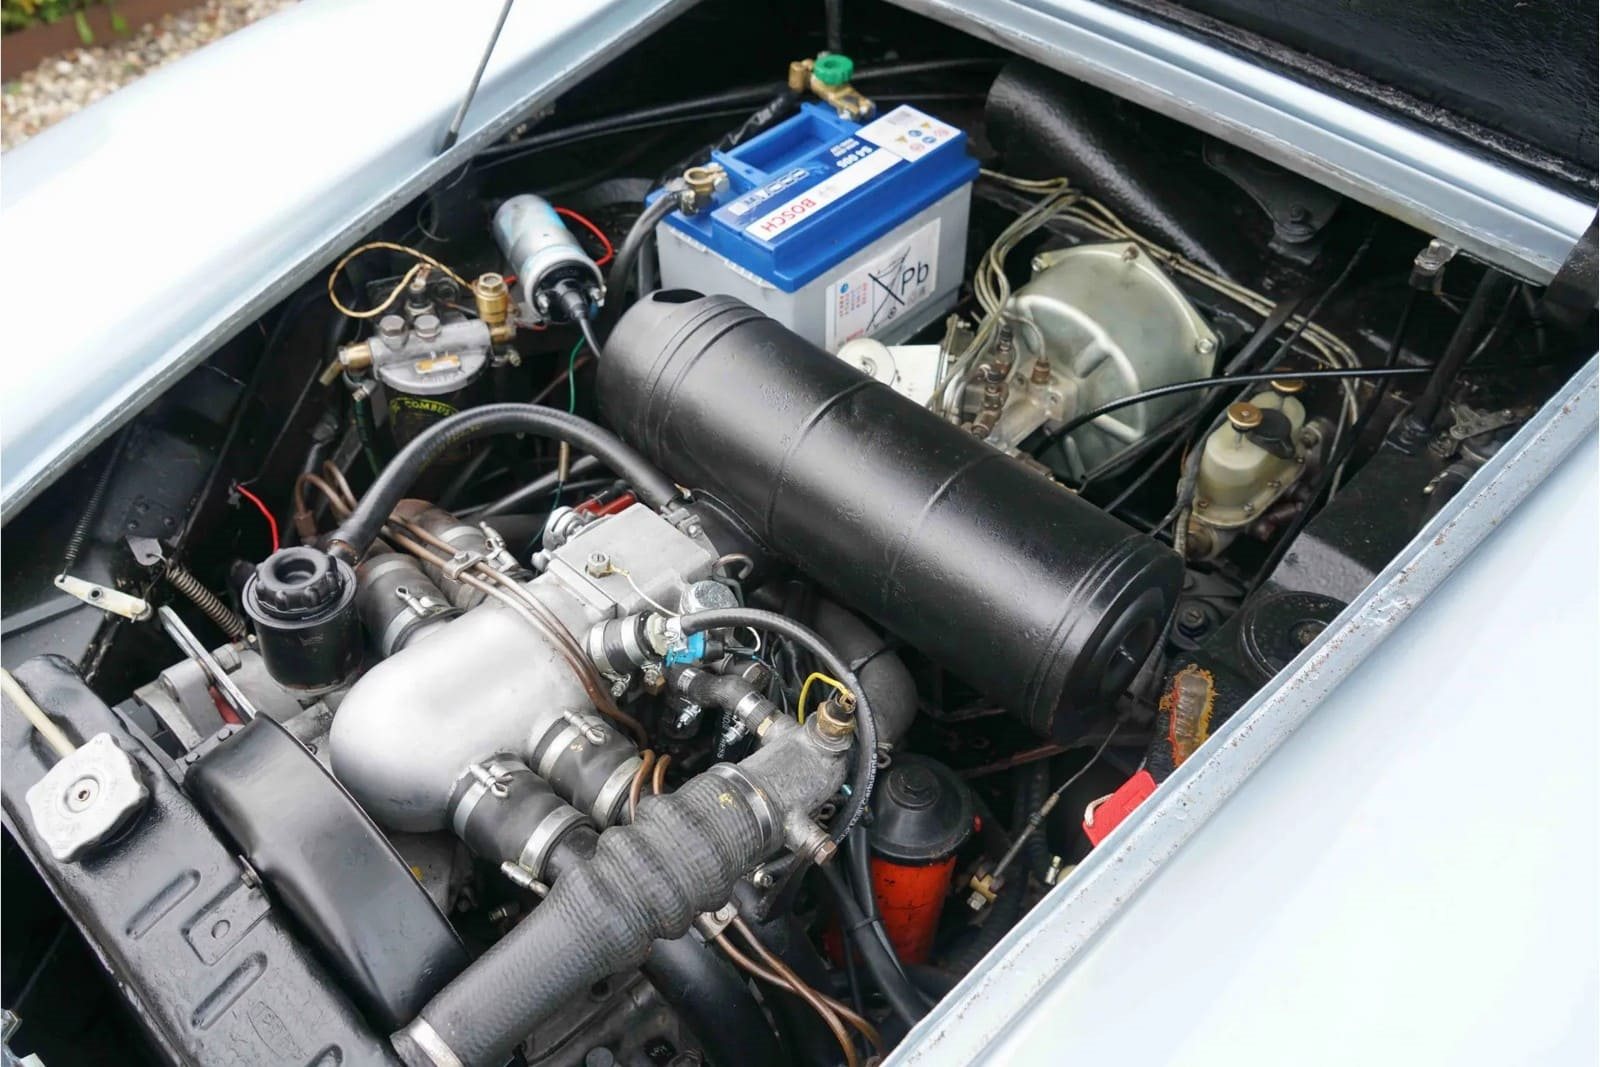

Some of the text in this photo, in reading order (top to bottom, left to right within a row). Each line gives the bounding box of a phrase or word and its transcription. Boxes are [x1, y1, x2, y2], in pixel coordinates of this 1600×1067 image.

[760, 198, 816, 232] BOSCH
[901, 261, 929, 295] Pb
[404, 400, 453, 416] COMBUS
